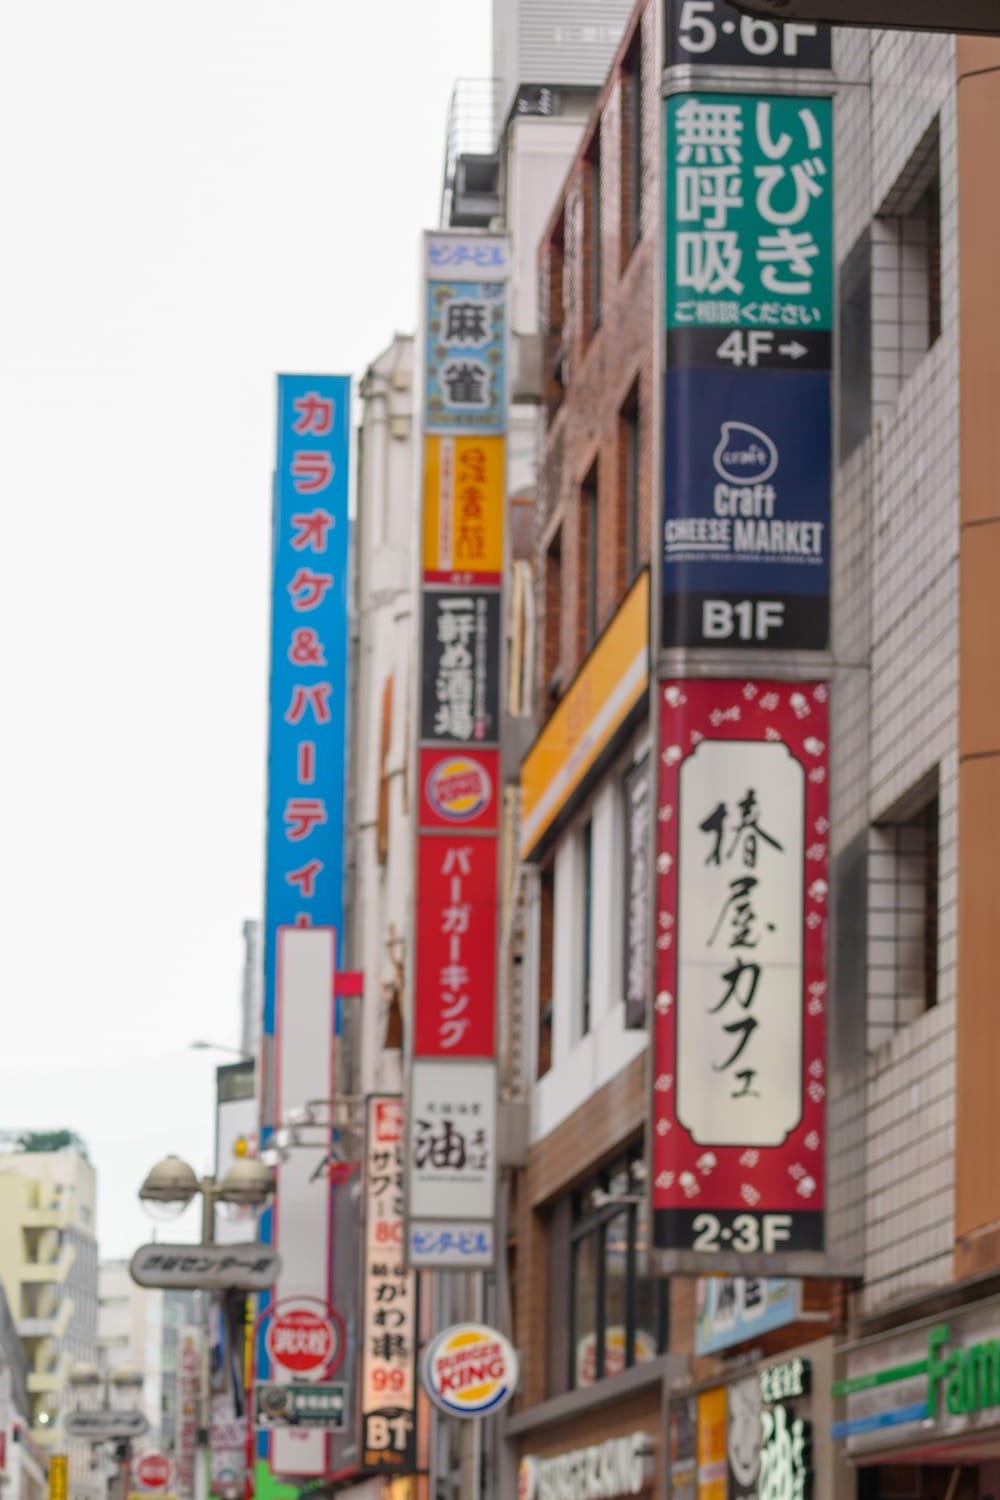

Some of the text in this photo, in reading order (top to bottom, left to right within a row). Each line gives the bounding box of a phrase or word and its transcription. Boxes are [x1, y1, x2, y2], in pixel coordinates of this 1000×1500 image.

[675, 99, 744, 295] 無呼吸
[754, 101, 827, 295] いびき
[674, 301, 821, 326] ご相談ください
[445, 302, 488, 404] 麻雀
[717, 330, 774, 367] 4F
[713, 483, 776, 517] Craft
[664, 517, 825, 555] CHEESE MARKET
[702, 600, 785, 640] B1F
[284, 393, 335, 926] カラオケ&パーティ
[440, 847, 473, 1048] バーガーキング
[699, 789, 785, 1099] 椿屋カフェ
[436, 1343, 503, 1371] BURGER
[372, 1367, 406, 1391] 99
[438, 1360, 506, 1397] KING
